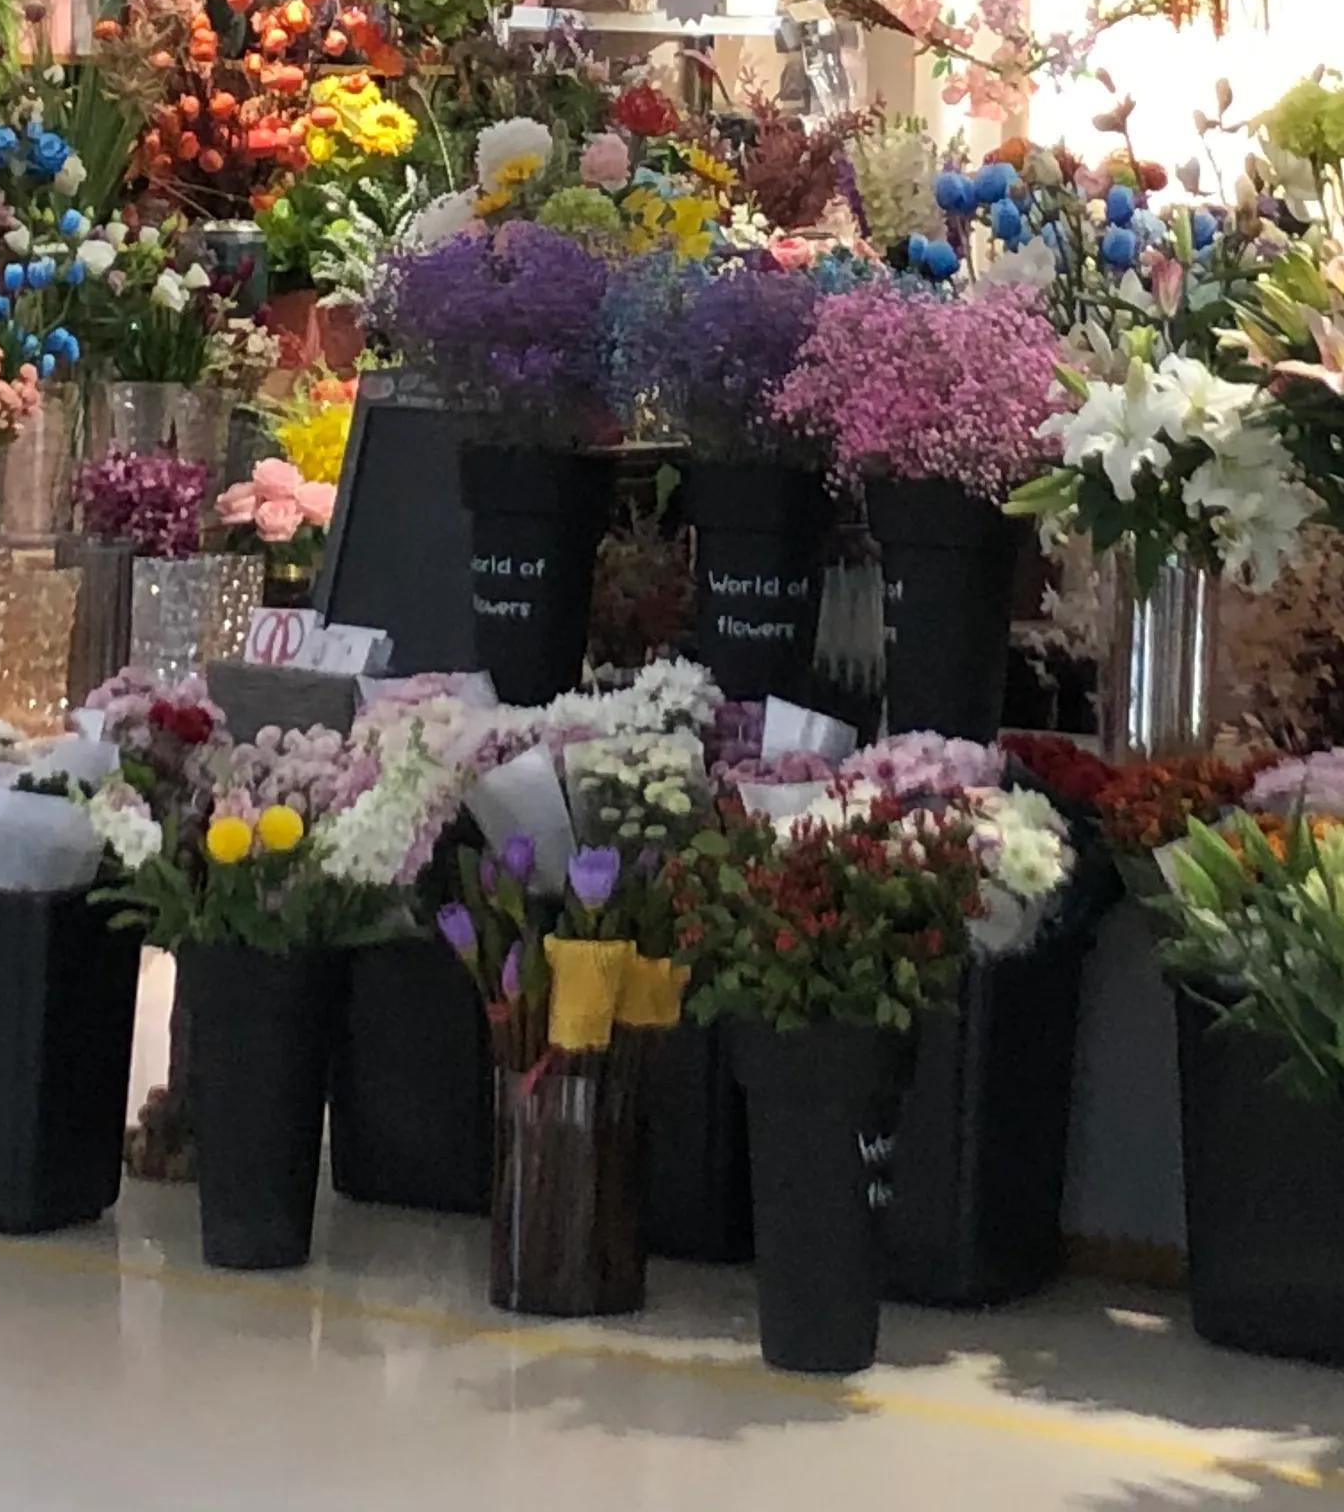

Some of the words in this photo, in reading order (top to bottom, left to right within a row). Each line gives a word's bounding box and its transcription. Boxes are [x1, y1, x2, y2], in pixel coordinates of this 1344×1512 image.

[519, 557, 546, 579] of
[708, 569, 780, 597] World
[717, 614, 797, 639] flowers
